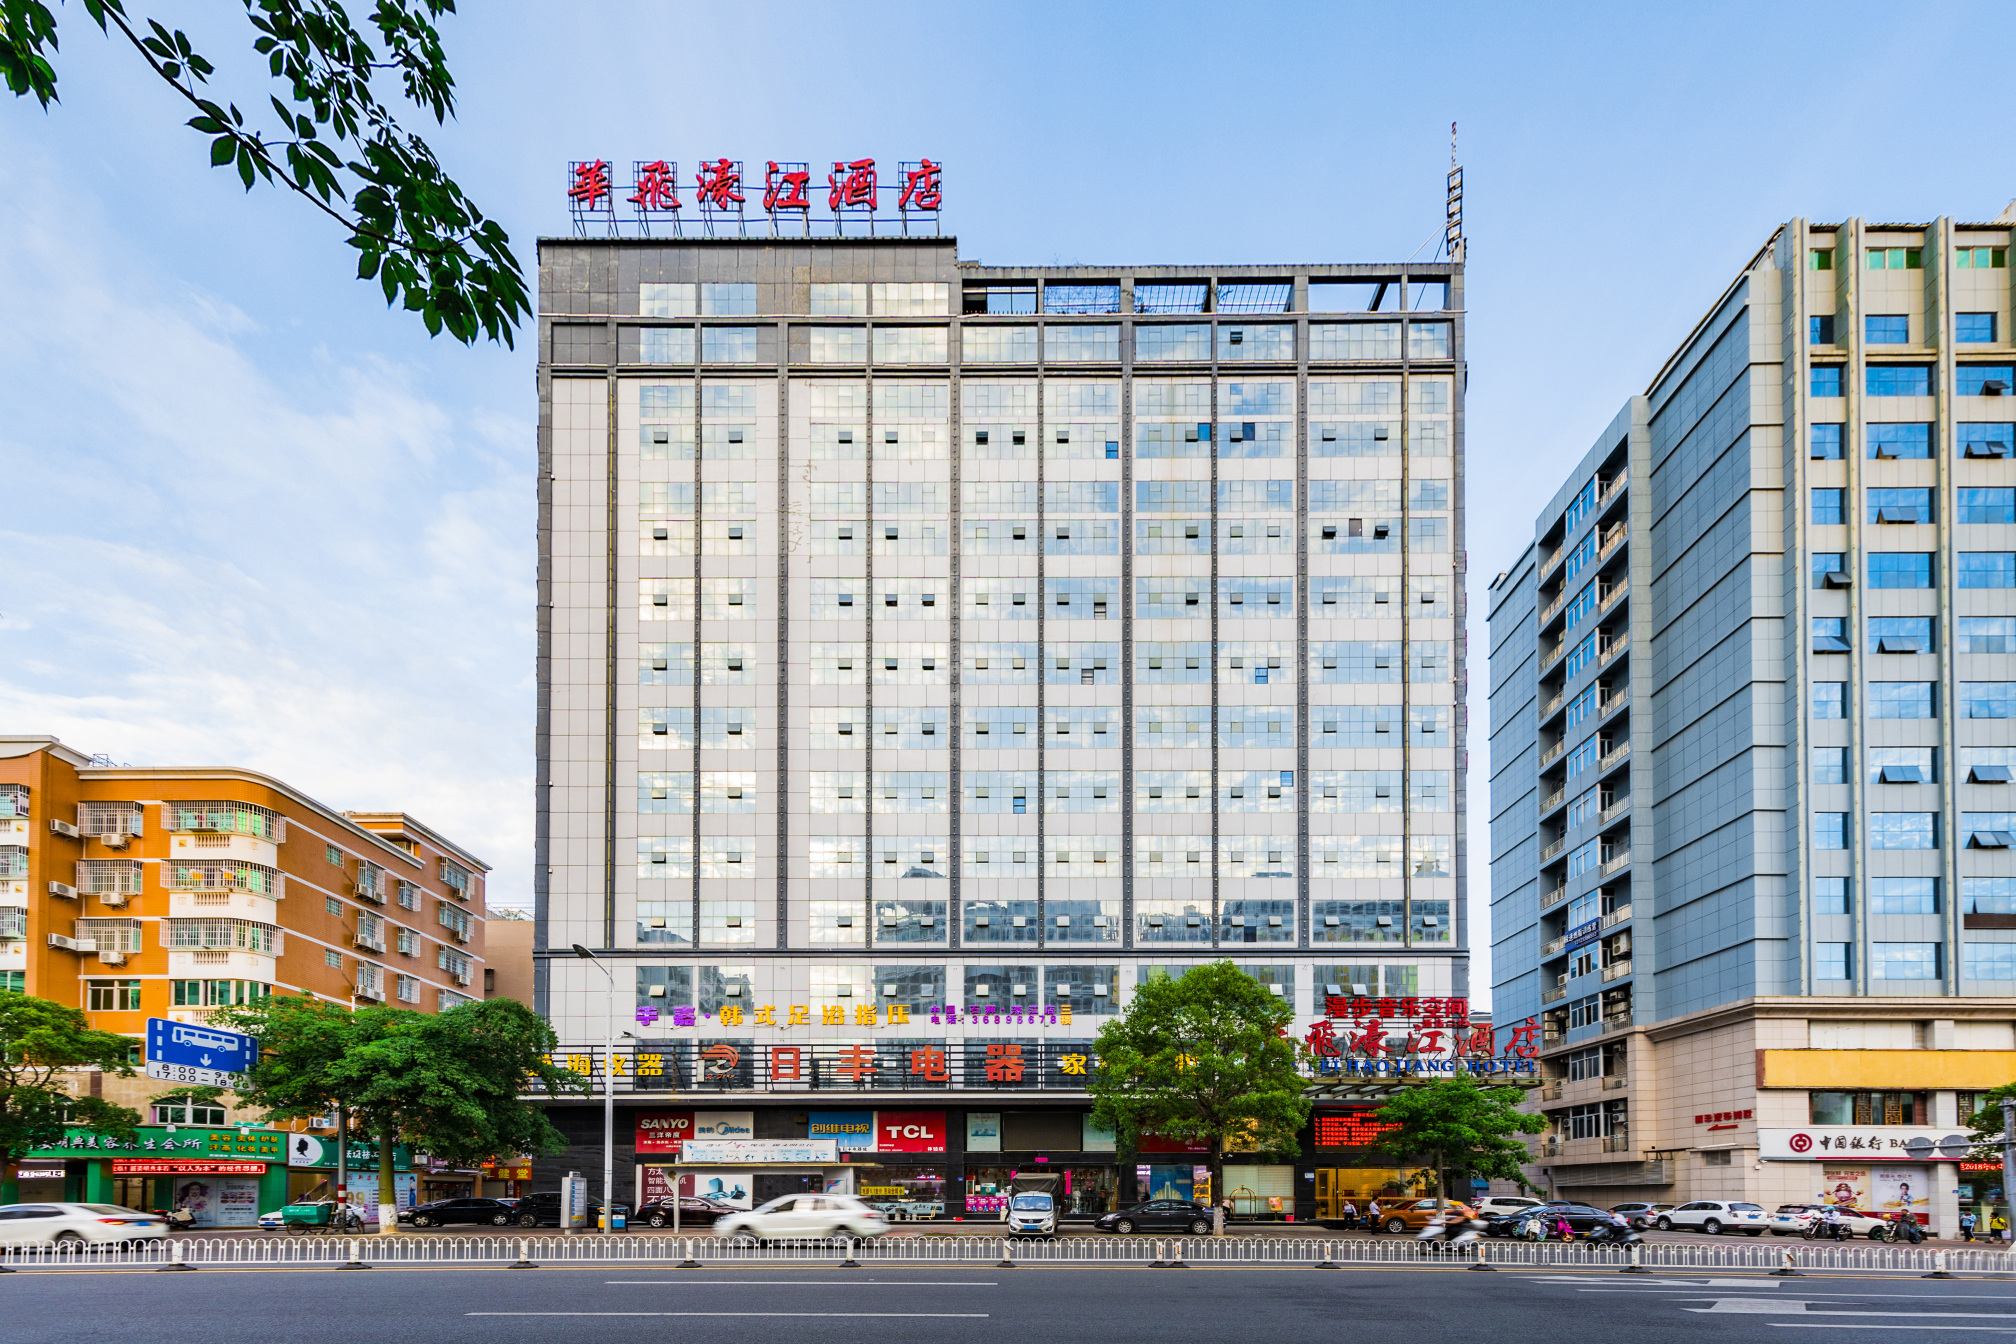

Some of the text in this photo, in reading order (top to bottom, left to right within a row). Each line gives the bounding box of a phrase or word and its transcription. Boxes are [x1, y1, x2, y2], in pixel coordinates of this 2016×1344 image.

[1325, 997, 1468, 1018] 漫步音乐空间
[771, 1044, 1026, 1082] 日丰电器
[1468, 1060, 1539, 1073] HOTEL
[640, 1117, 689, 1130] SANYO
[811, 1123, 871, 1134] 创维电视
[886, 1124, 934, 1139] TCL
[1819, 1135, 1884, 1151] 中国银行
[647, 1177, 687, 1185] 智能机
